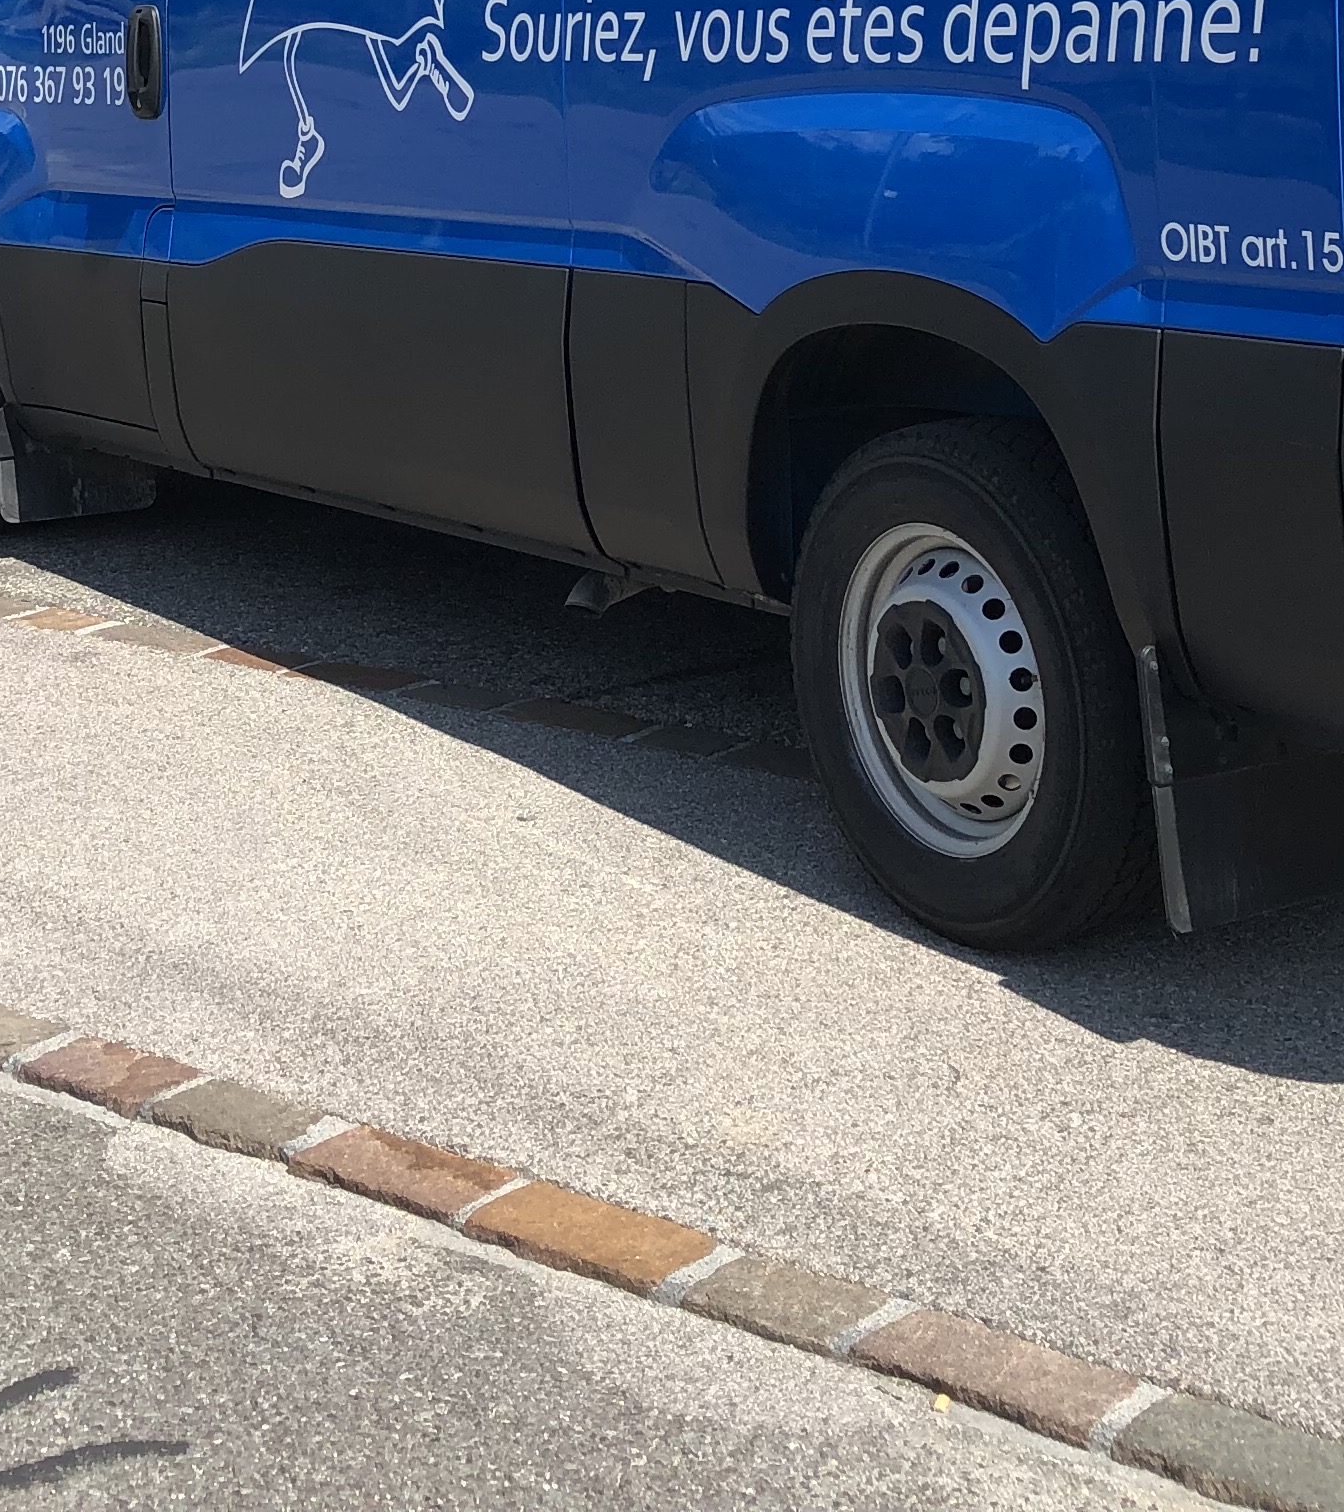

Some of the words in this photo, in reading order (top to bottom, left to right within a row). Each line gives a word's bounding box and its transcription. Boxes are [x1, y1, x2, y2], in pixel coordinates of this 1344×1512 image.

[41, 24, 75, 54] 1196
[80, 21, 125, 55] Gland
[674, 7, 791, 64] vous
[33, 65, 67, 104] 367
[72, 66, 96, 105] 93
[103, 66, 125, 106] 19
[1160, 222, 1230, 265] OIBT
